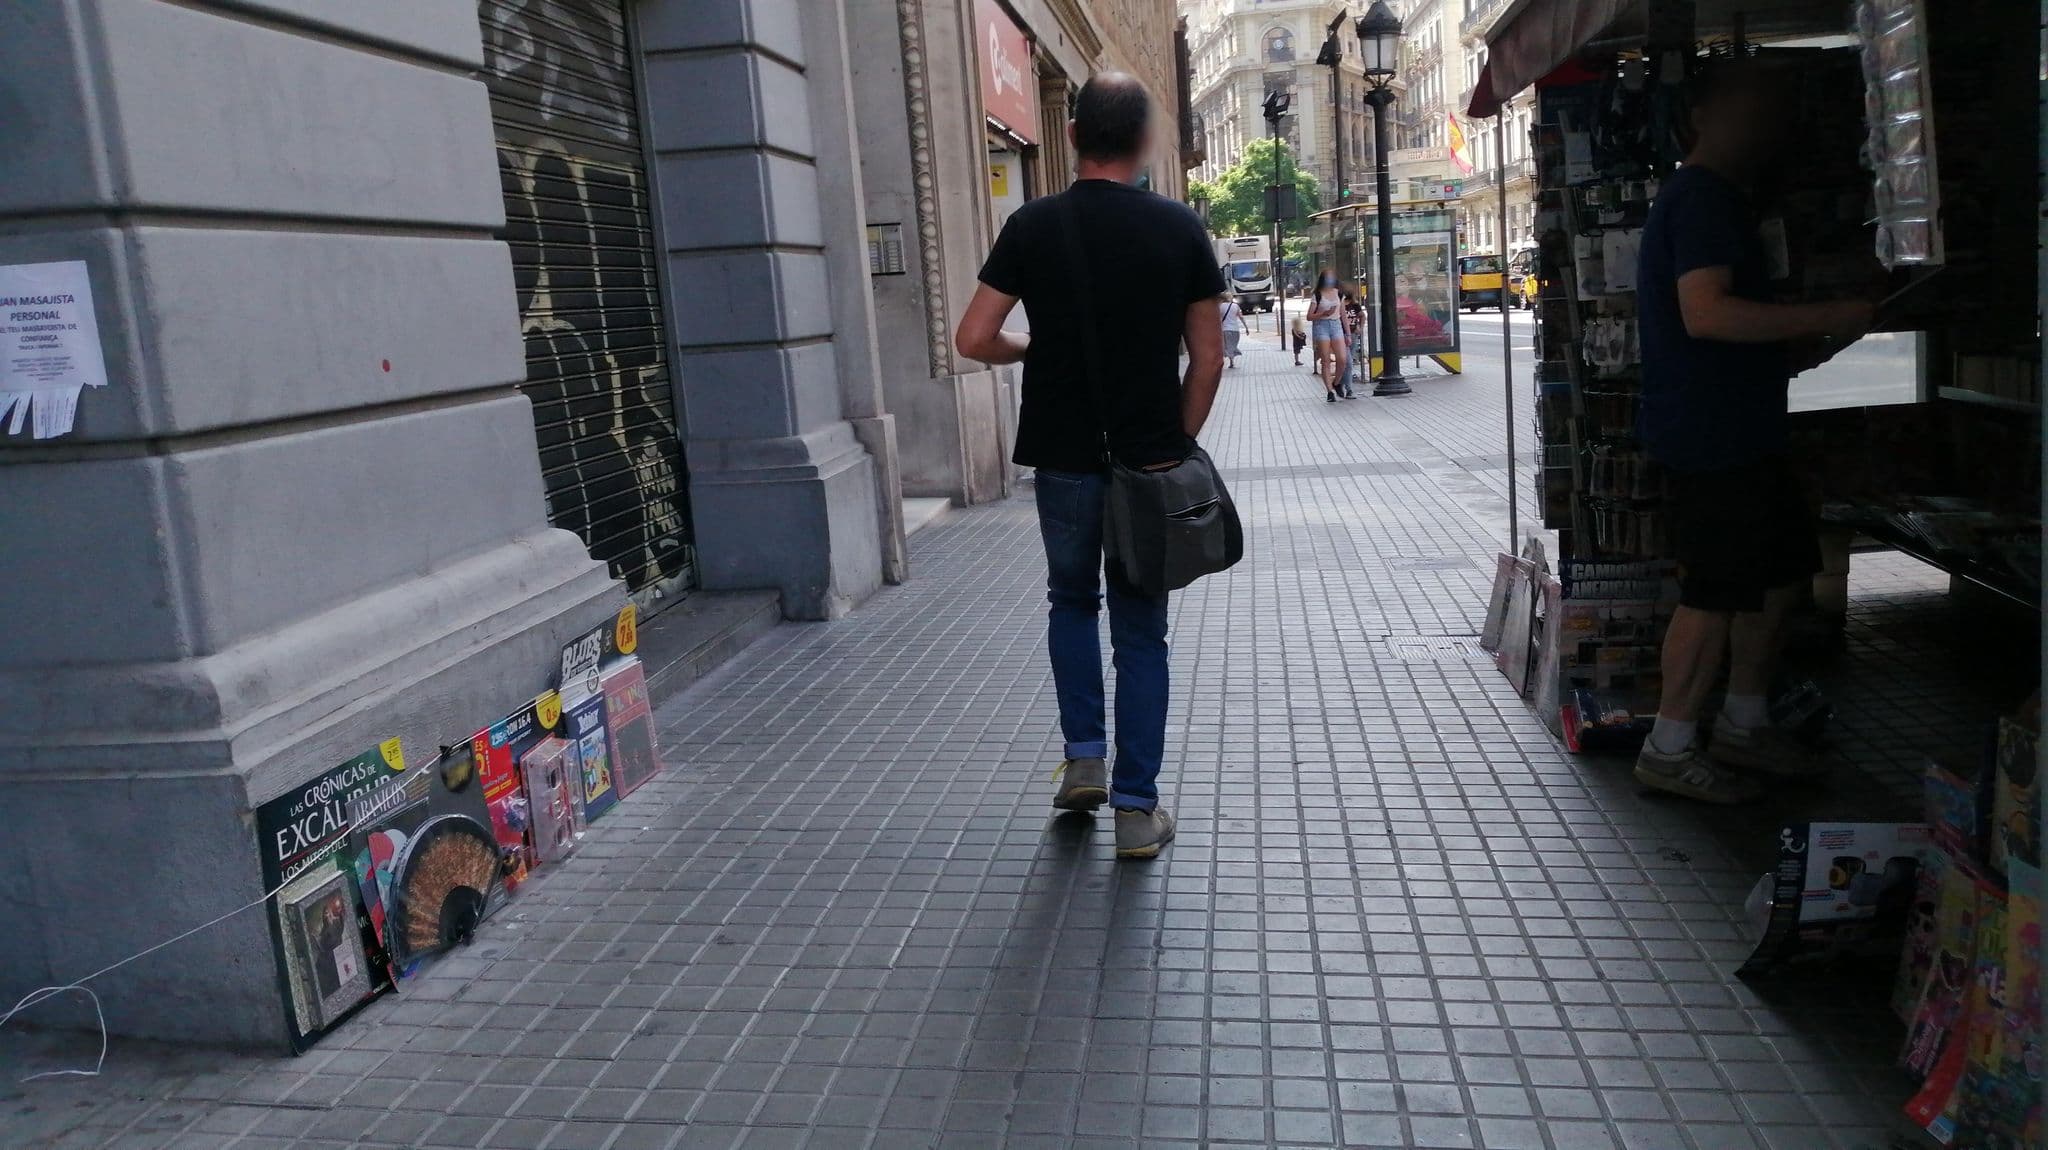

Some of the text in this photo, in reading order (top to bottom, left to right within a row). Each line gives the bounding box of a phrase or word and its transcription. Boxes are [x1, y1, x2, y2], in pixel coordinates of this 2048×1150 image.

[10, 311, 61, 322] PERSONAL
[19, 294, 75, 306] MASAJISTA
[562, 628, 602, 680] BLUES
[290, 763, 376, 817] LAS CRÓNICAS DE
[354, 781, 407, 825] ABANICOS
[281, 838, 349, 883] LOS MITOS DEL
